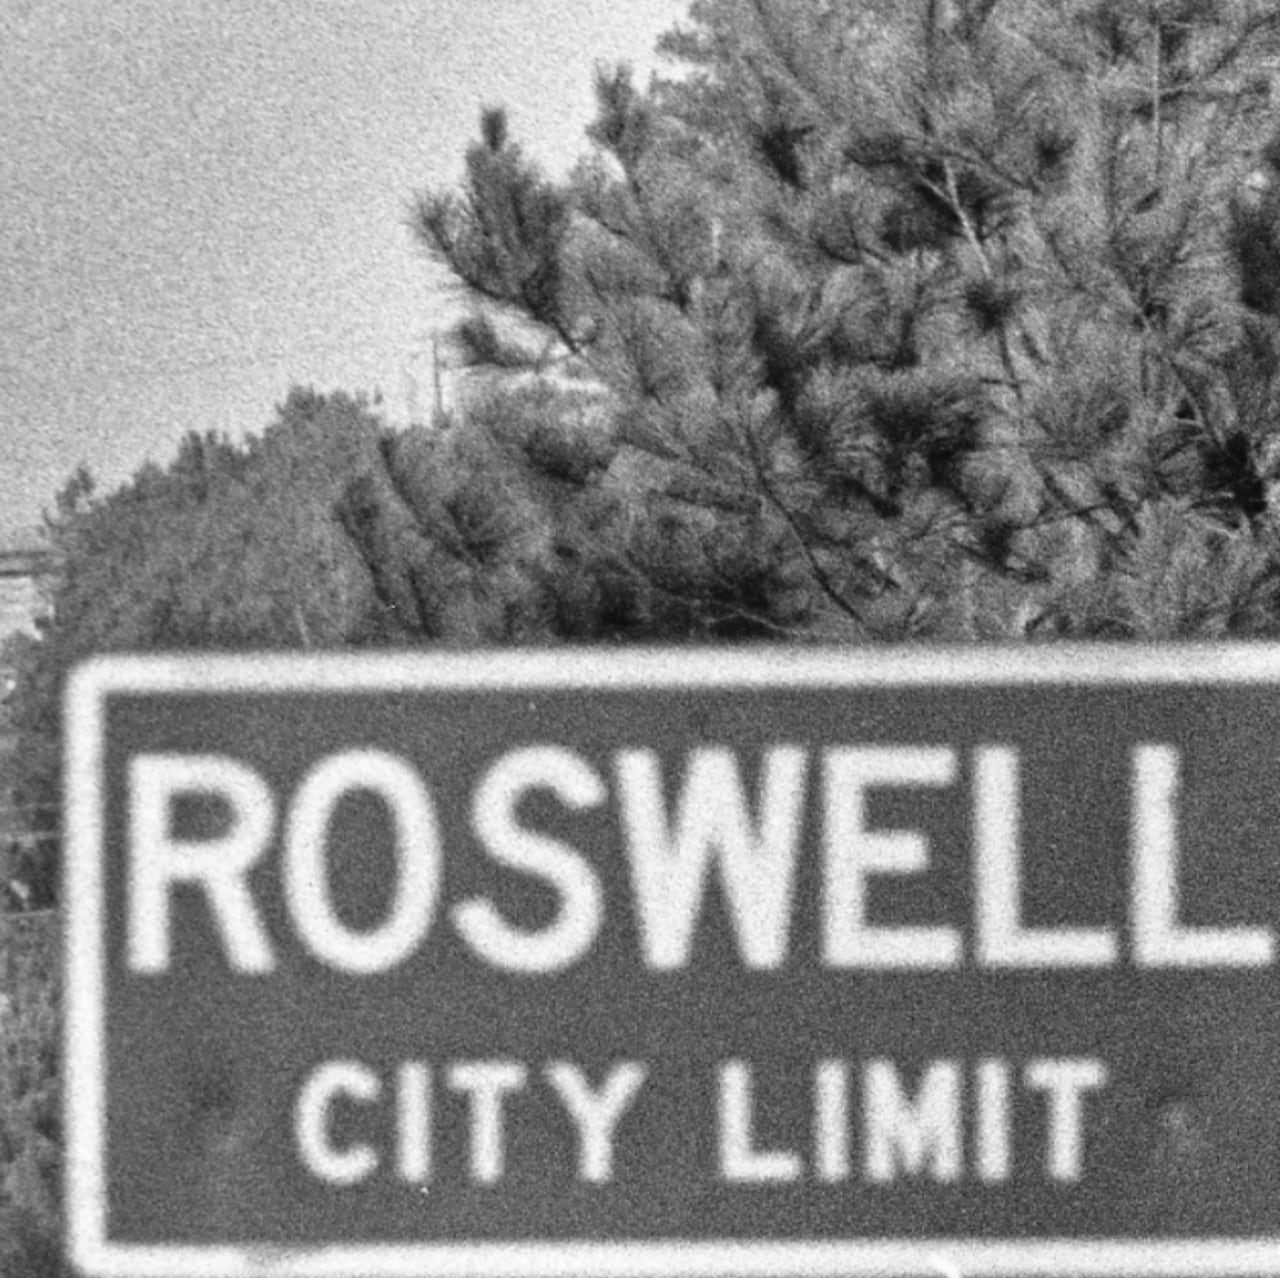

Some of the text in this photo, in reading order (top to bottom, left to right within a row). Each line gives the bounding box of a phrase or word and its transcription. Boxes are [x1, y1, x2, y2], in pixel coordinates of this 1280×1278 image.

[126, 742, 1278, 977] ROSWELL
[293, 1057, 1107, 1185] CITY LIMIT
